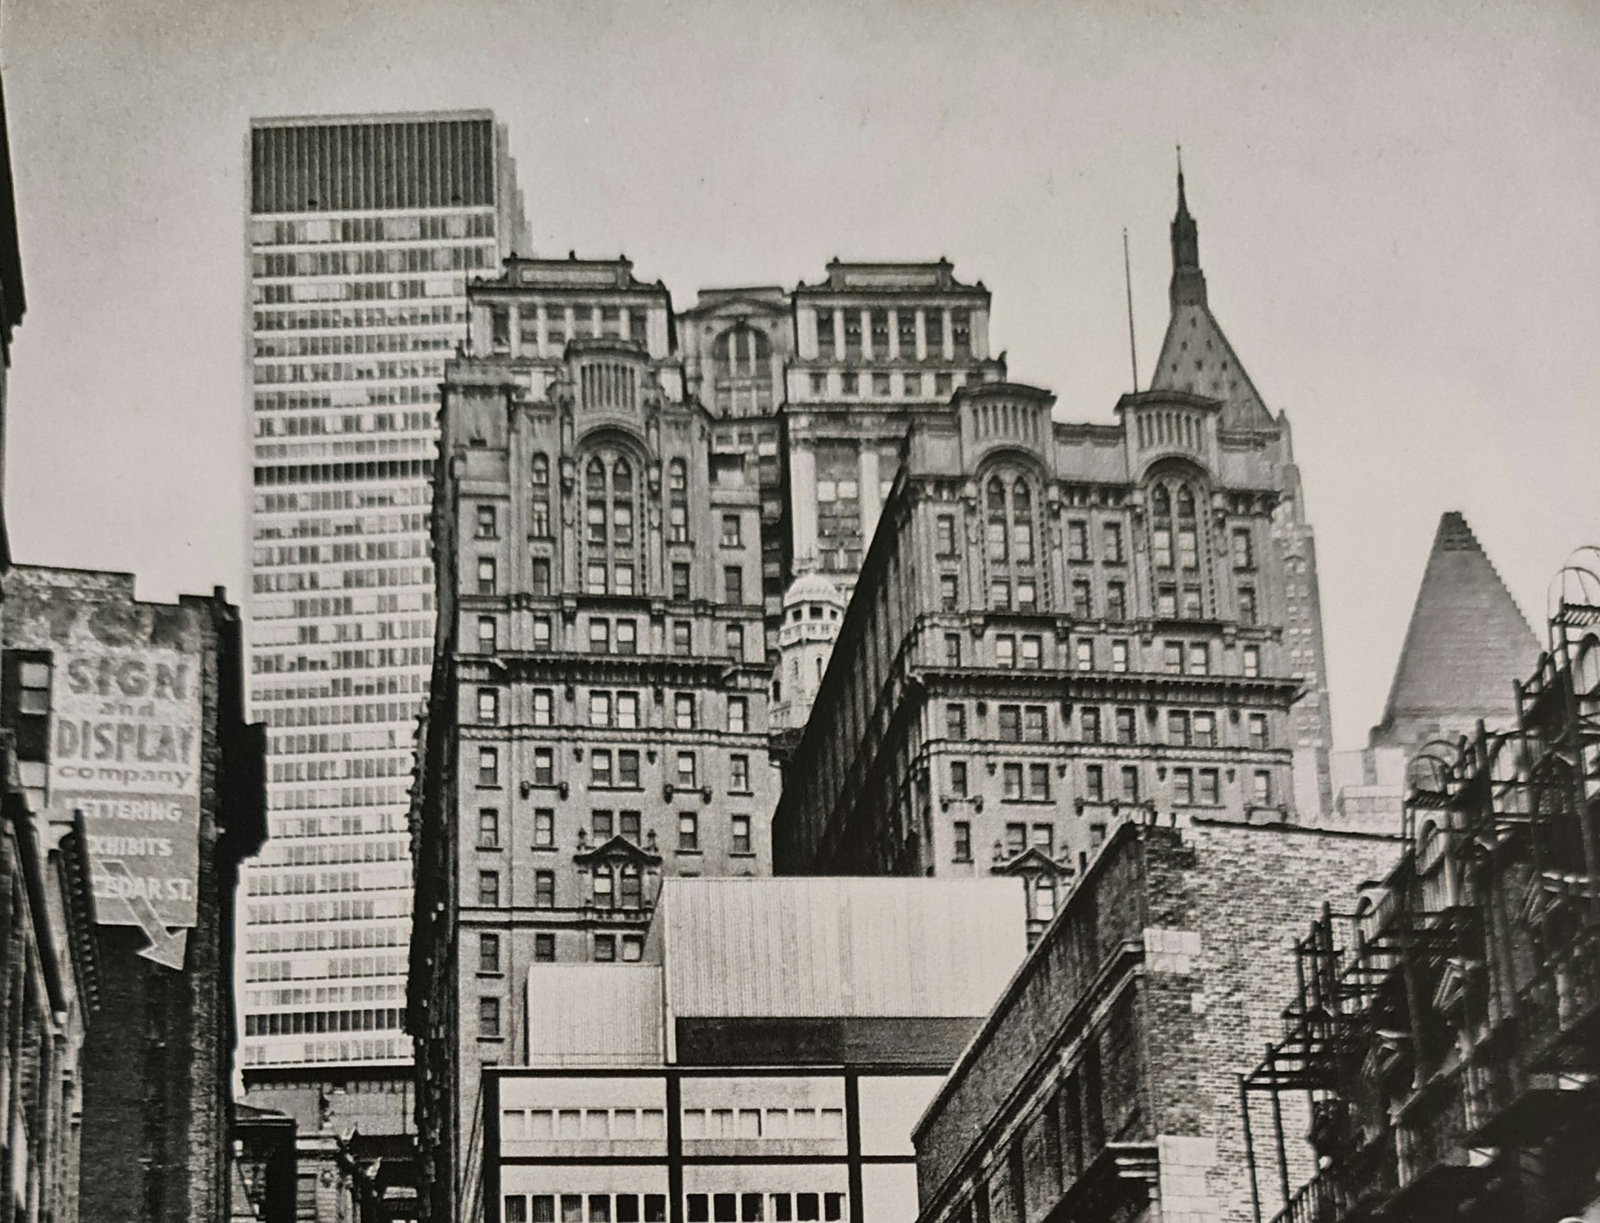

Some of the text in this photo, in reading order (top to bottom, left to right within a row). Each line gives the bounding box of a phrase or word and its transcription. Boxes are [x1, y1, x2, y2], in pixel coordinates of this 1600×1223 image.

[67, 657, 189, 700] SIGN
[99, 701, 155, 717] and
[57, 719, 193, 764] DISPLAY
[57, 766, 192, 788] company
[88, 836, 174, 857] XHIBITS
